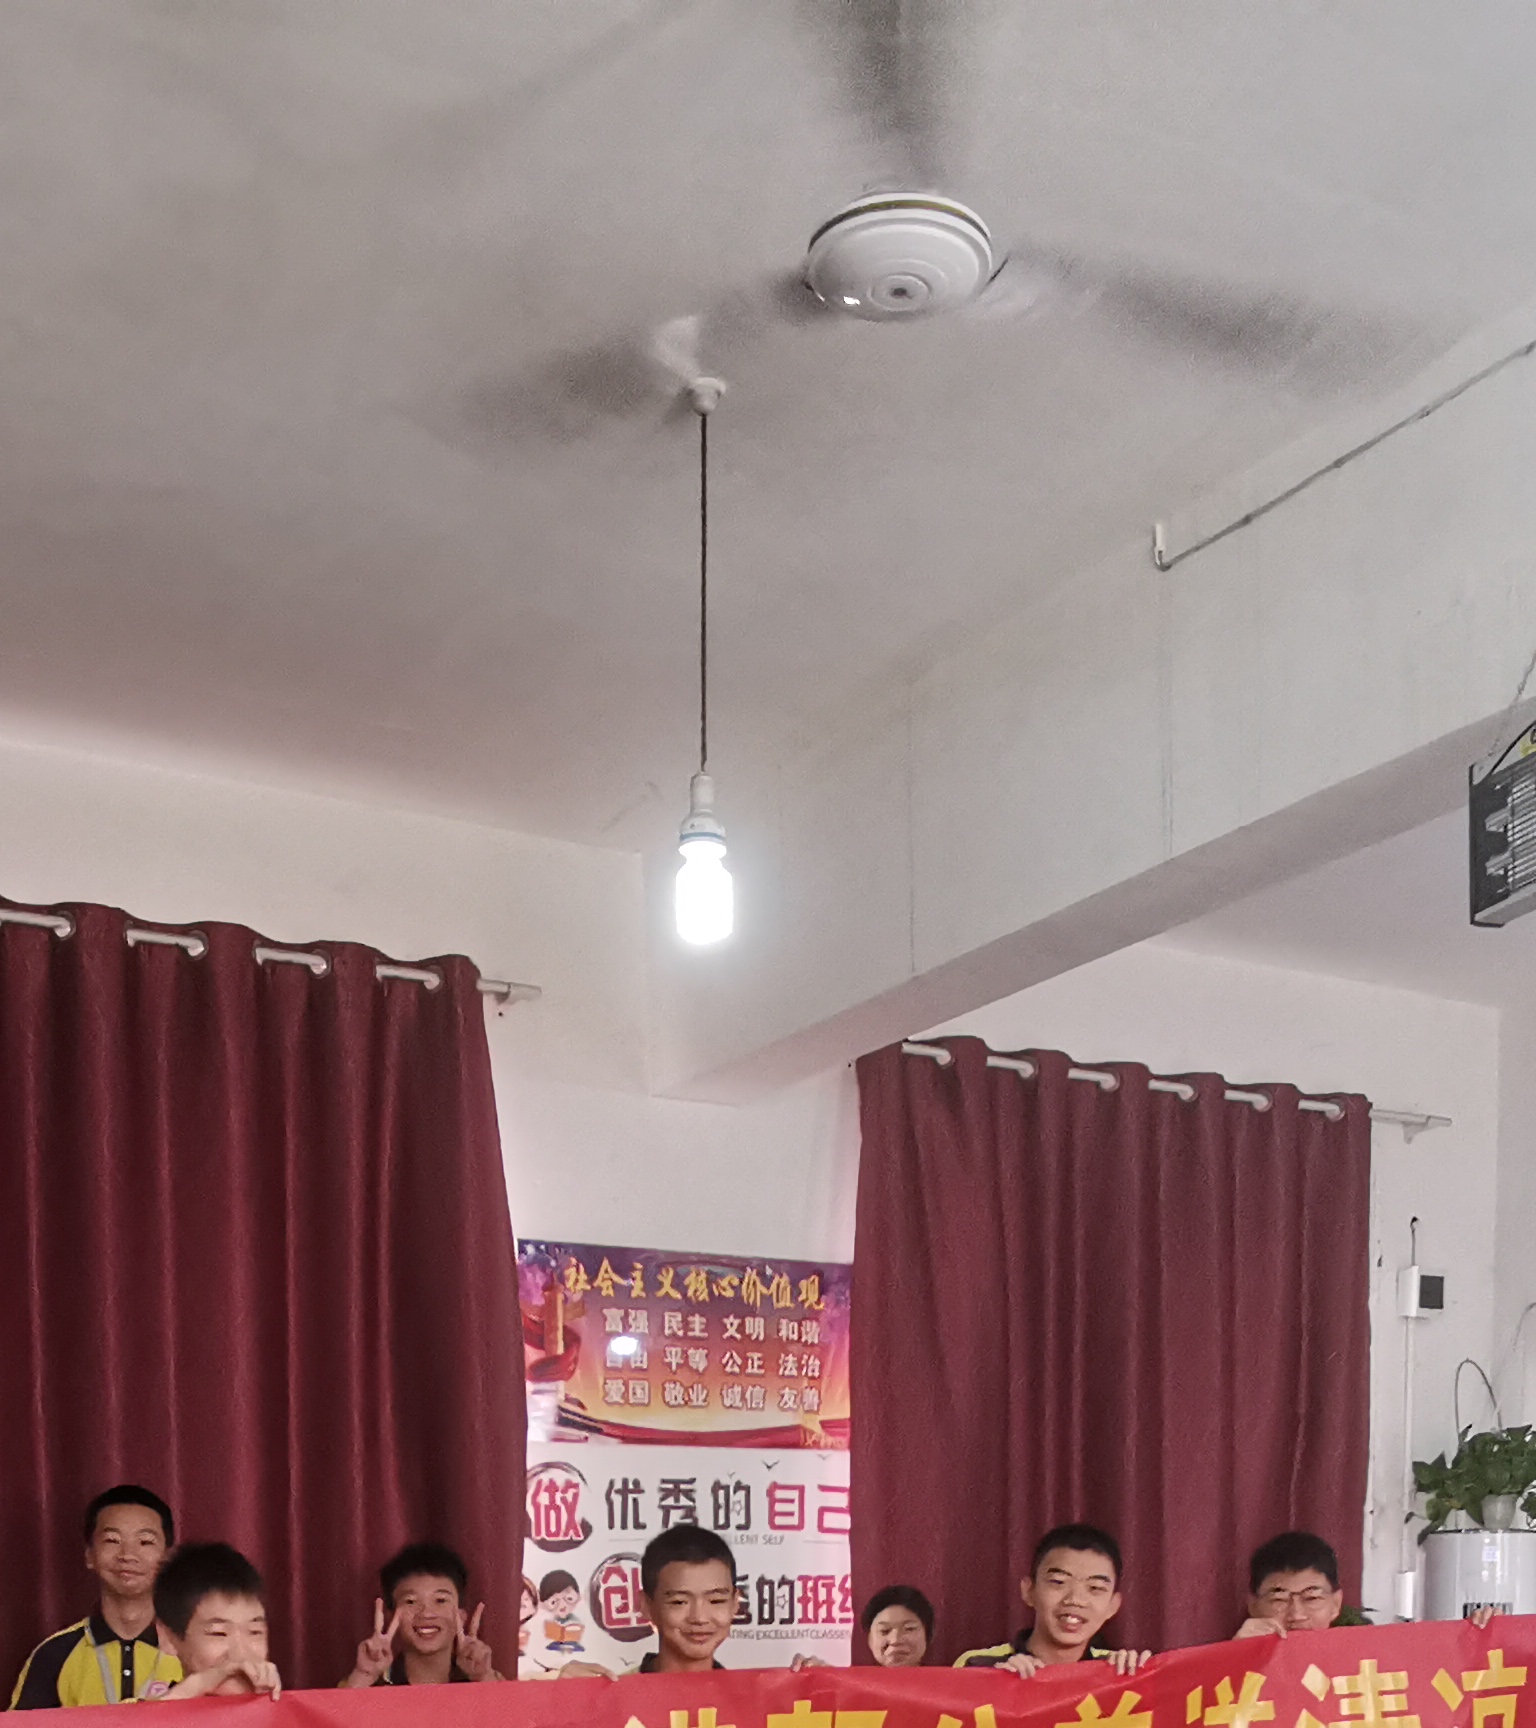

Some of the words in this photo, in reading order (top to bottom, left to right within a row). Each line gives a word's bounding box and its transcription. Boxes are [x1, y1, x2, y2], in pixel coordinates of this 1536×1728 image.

[565, 1255, 826, 1311] 社会主义核心价值观
[601, 1307, 649, 1335] 富强
[663, 1311, 709, 1338] 民主
[722, 1314, 765, 1341] 文明
[778, 1318, 821, 1345] 和谐
[663, 1346, 708, 1373] 平等
[721, 1350, 765, 1375] 公正
[778, 1353, 821, 1378] 法治
[603, 1379, 650, 1405] 爱国
[663, 1381, 709, 1407] 敬业
[721, 1383, 766, 1409] 诚信
[778, 1387, 821, 1412] 友善
